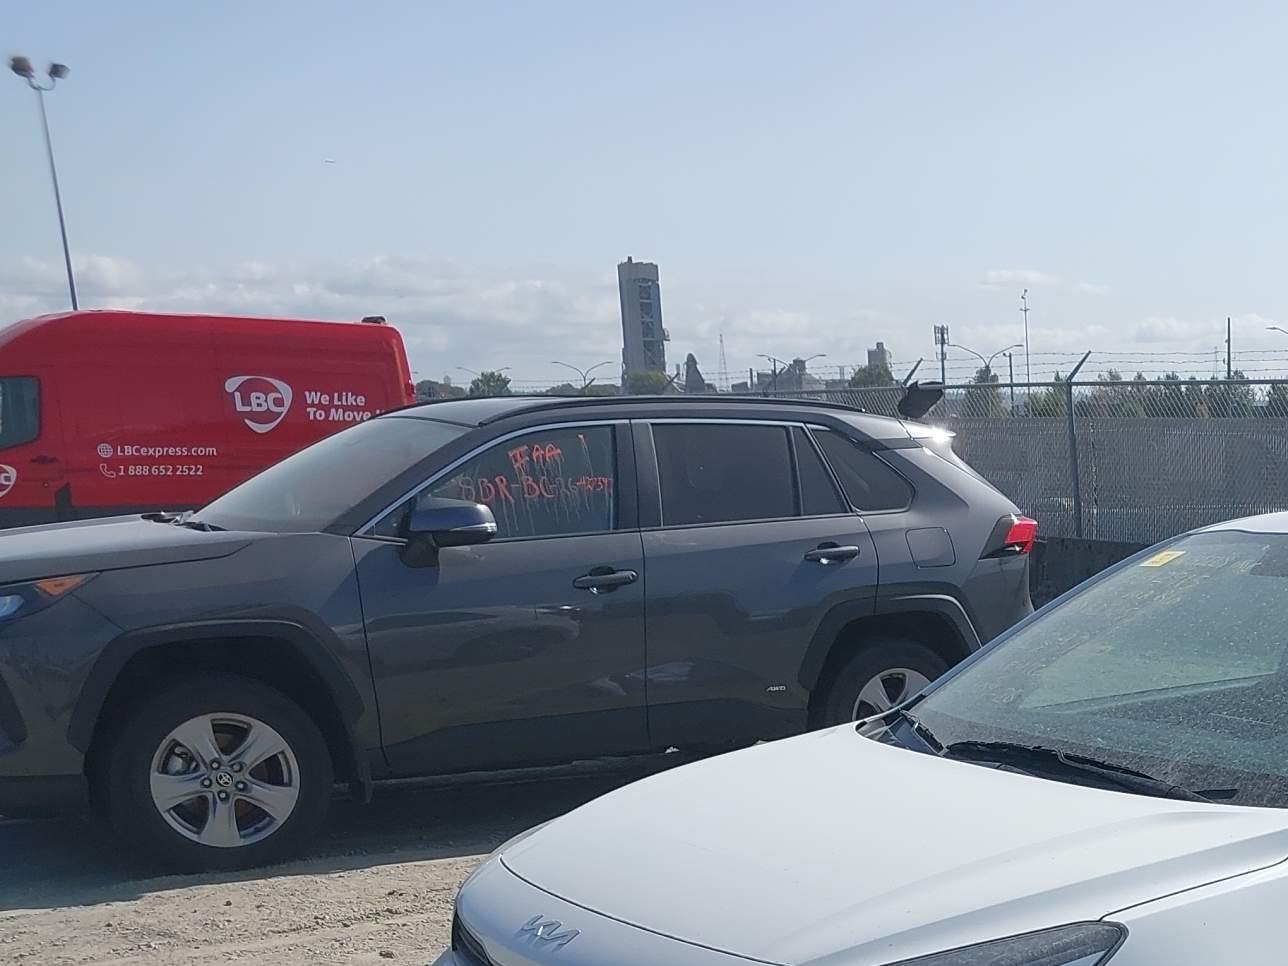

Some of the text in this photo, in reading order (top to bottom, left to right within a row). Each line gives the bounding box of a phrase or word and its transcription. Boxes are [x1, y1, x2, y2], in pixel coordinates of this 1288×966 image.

[235, 391, 285, 412] LBC
[305, 391, 366, 406] We Like
[306, 408, 372, 422] To Move
[117, 445, 218, 458] LBCexpress.com
[119, 465, 203, 476] 1 888 652 2522
